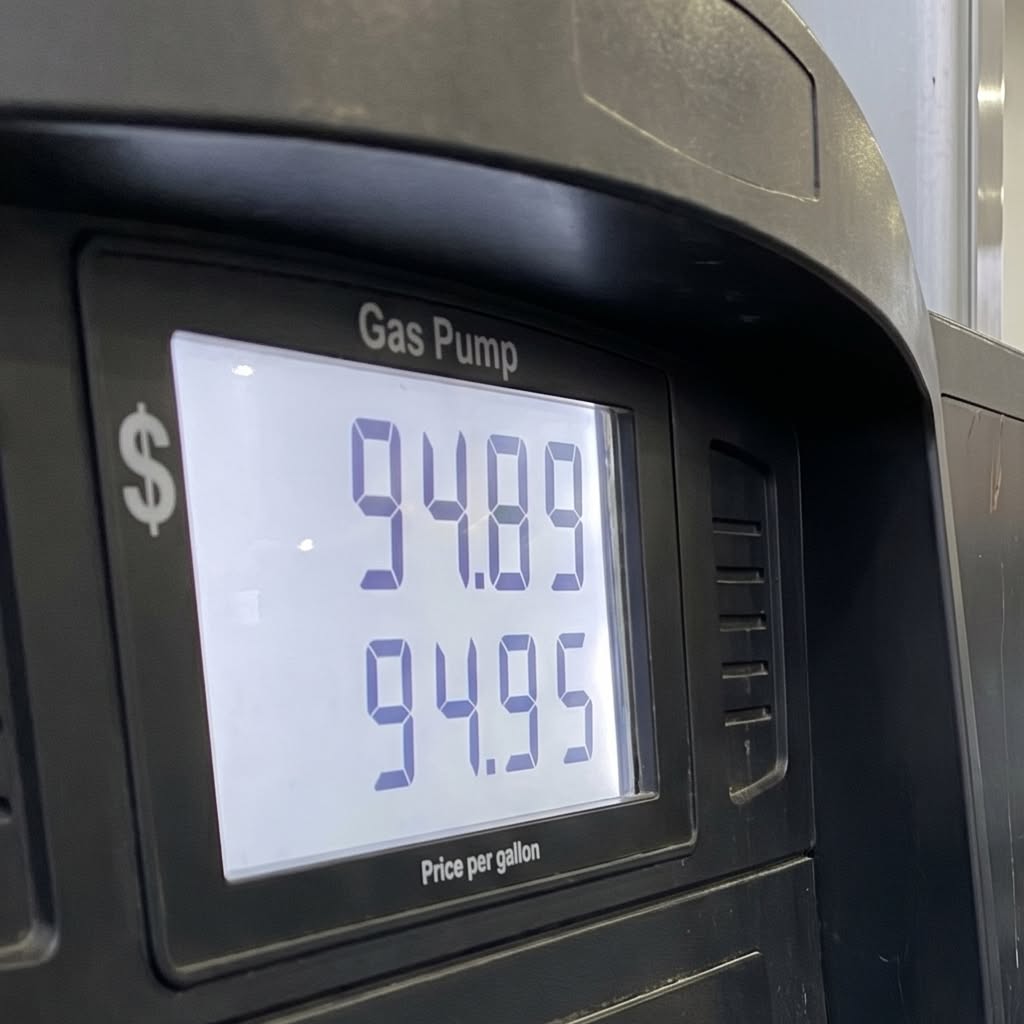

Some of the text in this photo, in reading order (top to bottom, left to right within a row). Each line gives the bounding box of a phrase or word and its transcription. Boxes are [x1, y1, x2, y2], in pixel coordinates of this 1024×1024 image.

[358, 302, 519, 381] Gas Pump
[118, 402, 177, 537] $
[351, 417, 584, 592] 94.89
[365, 632, 594, 792] 94.95
[421, 840, 540, 885] Price per gallon
